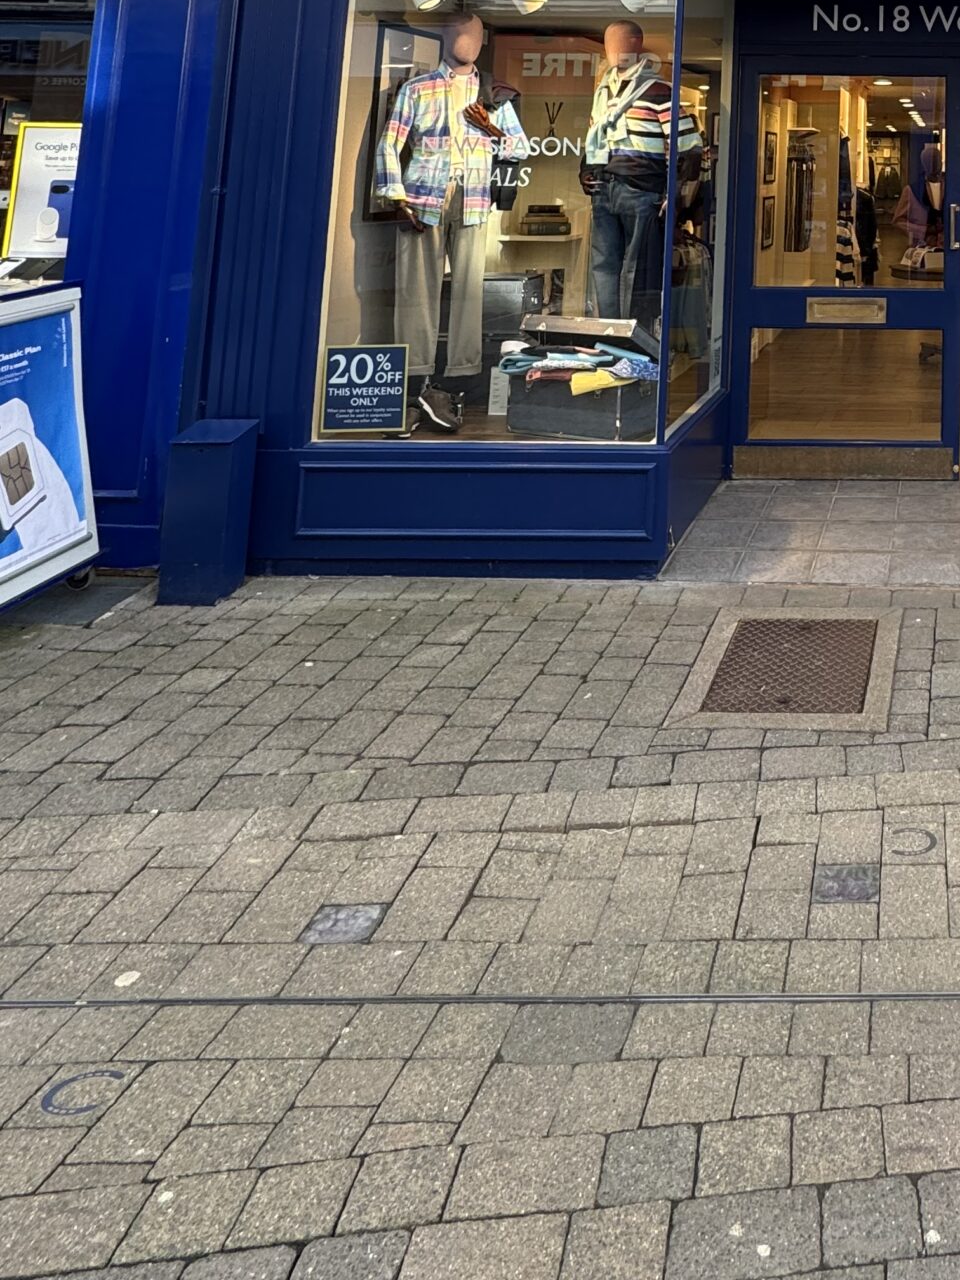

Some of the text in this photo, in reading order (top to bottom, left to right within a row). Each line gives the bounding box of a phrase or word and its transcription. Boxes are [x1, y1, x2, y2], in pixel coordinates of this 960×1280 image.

[35, 142, 68, 154] Google
[490, 136, 581, 157] SEASON
[328, 353, 403, 384] 20% OFF
[327, 386, 403, 396] THIS WEEKEND
[350, 397, 379, 406] ONLY
